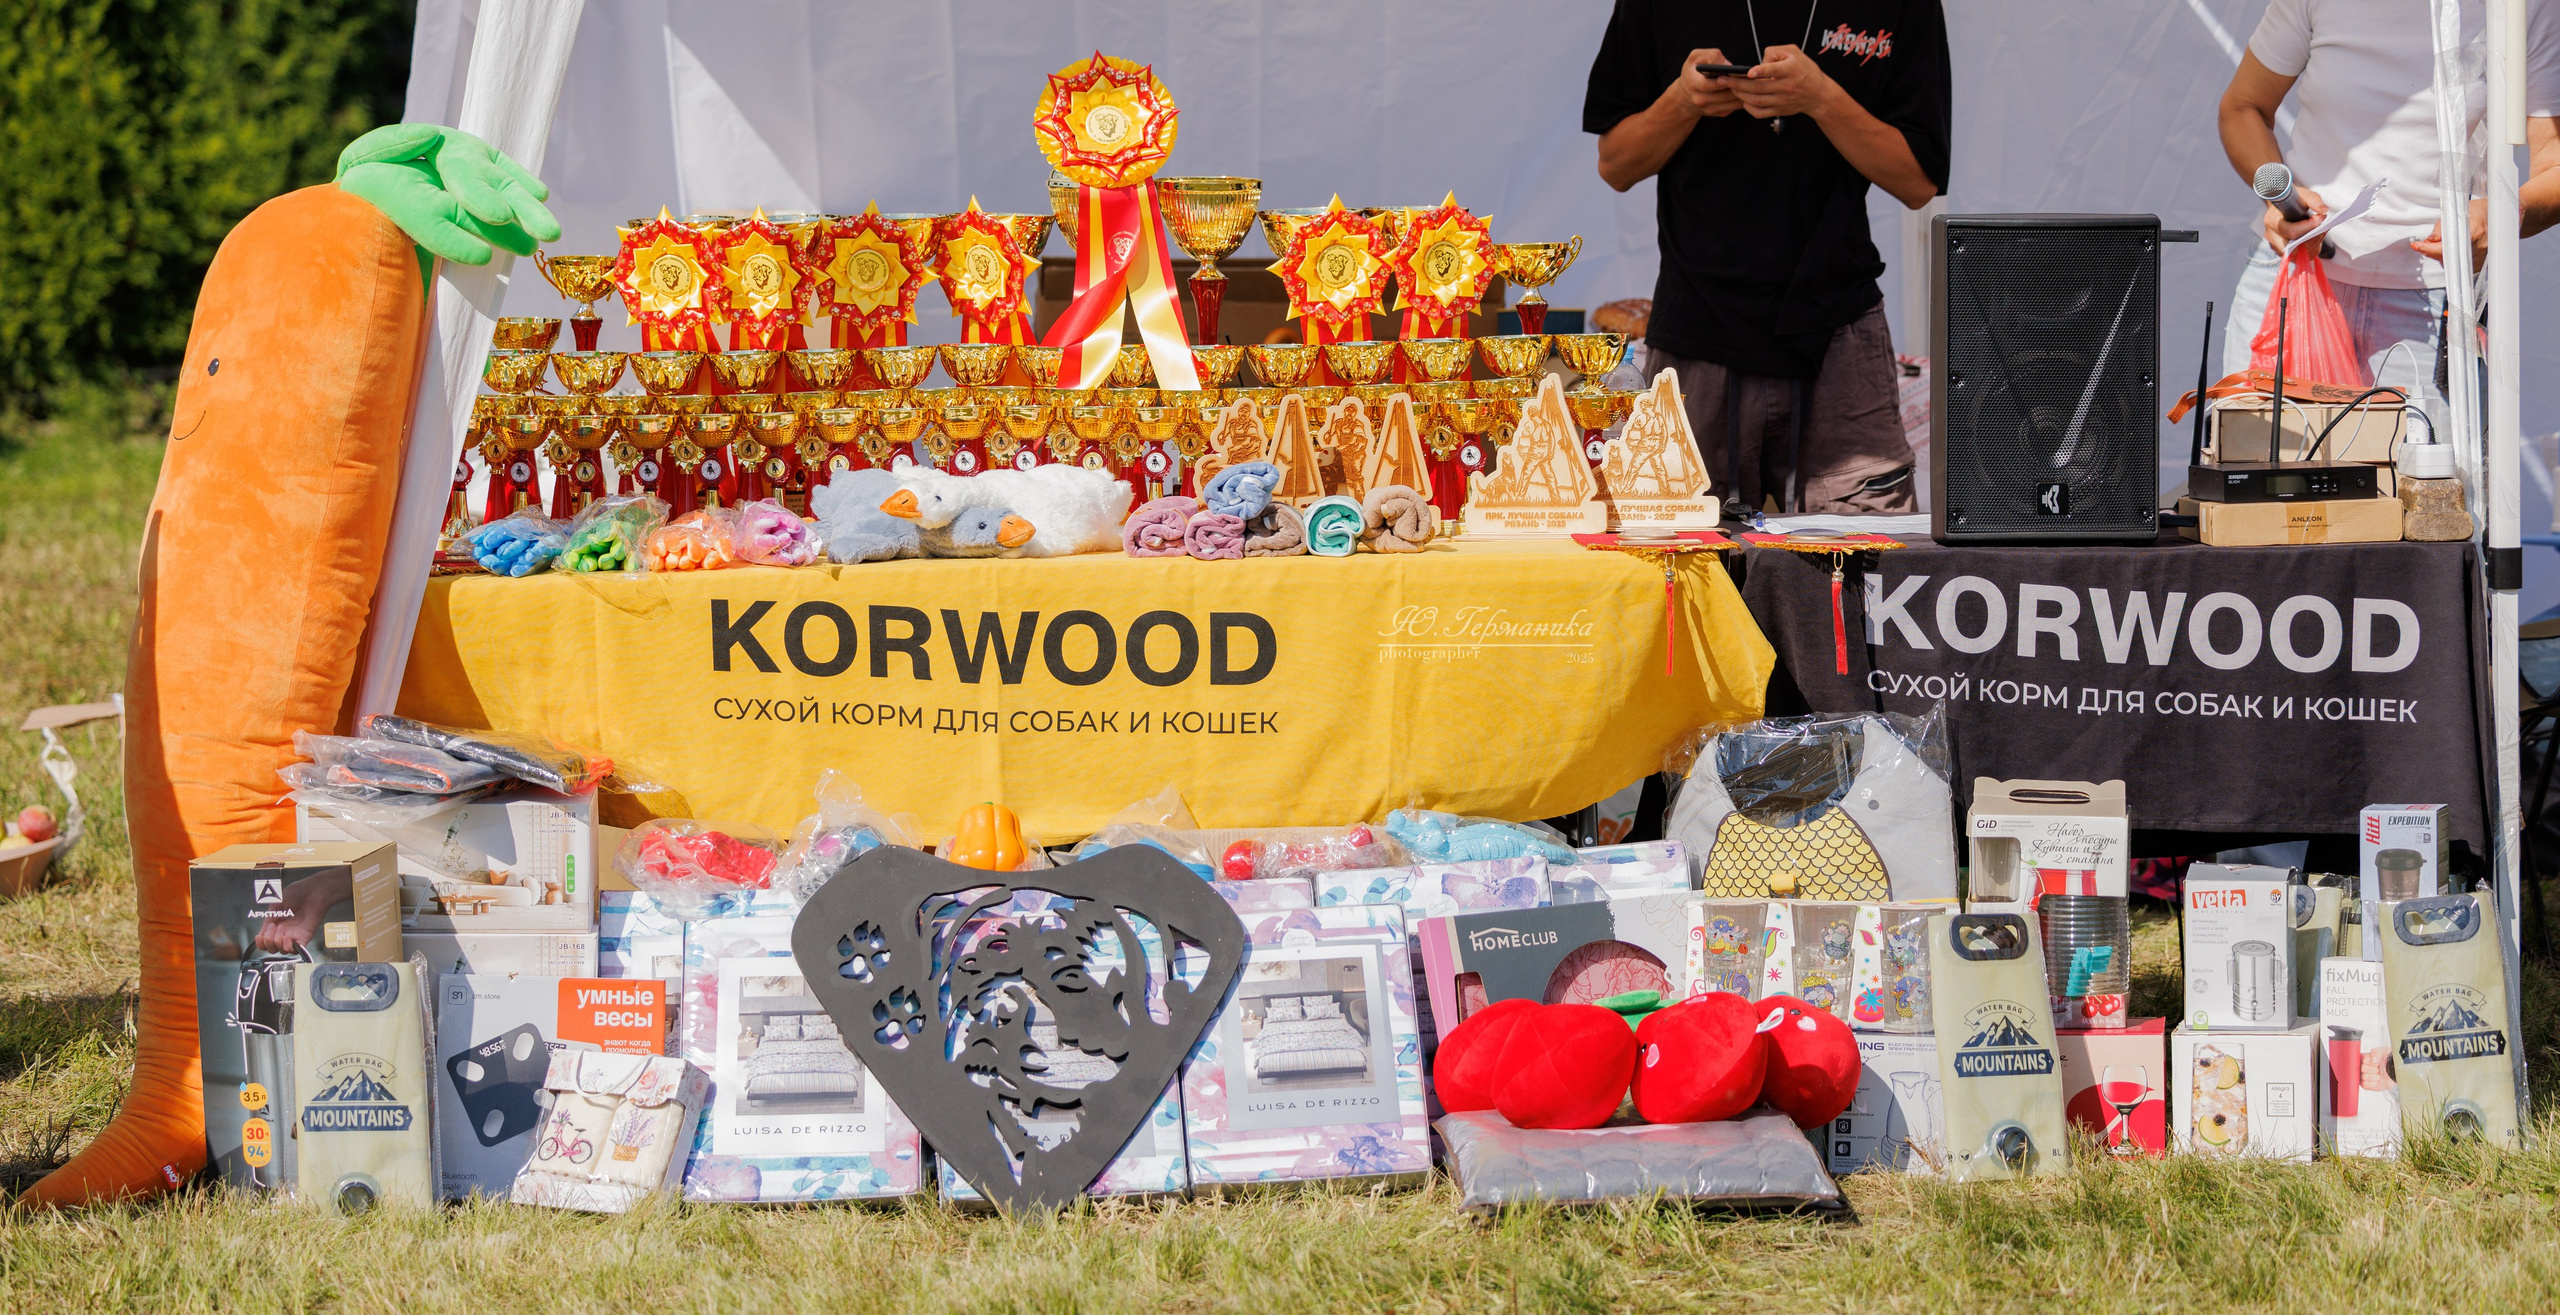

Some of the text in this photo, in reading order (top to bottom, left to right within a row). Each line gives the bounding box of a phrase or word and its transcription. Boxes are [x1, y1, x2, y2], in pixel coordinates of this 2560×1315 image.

[1619, 504, 1663, 513] ЛУЧШАЯ
[1665, 504, 1704, 513] СОБАКА
[1507, 511, 1546, 520] ЛУЧШАЯ
[1547, 511, 1585, 520] СОБАКА
[1608, 513, 1647, 521] РЯЗАНЬ
[1653, 512, 1676, 521] 2025
[1504, 520, 1541, 529] РЯЗАНЬ
[1546, 520, 1567, 528] 2025
[1864, 573, 2421, 674] KORWOOD
[709, 598, 1278, 687] KORWOOD
[1867, 669, 2418, 723] СУХОЙ КОРМ ДЛЯ СОБАК И КОШЕК
[712, 696, 1279, 736] СУХОЙ КОРМ ДЛЯ СОБАК И КОШЕК
[550, 811, 577, 819] JB-168
[2388, 815, 2431, 826] EXPEDITION
[1976, 819, 1998, 829] GiD
[2366, 814, 2380, 846] Hitt
[2047, 822, 2084, 841] Набор
[2029, 839, 2091, 858] Кувшин и
[2053, 853, 2114, 865] 2 стакана
[1470, 930, 1558, 952] HOMECLUB
[2326, 968, 2382, 987] fixMug
[2326, 986, 2348, 995] FALL
[2422, 988, 2472, 1001] WATER BAG
[577, 987, 655, 1010] умные
[1975, 1004, 2023, 1015] WATER BAG
[2325, 1008, 2349, 1017] MUG
[594, 1010, 653, 1028] весы
[604, 1039, 651, 1048] знают когда
[2407, 1034, 2499, 1060] MOUNTAINS
[605, 1047, 651, 1055] промолчать
[330, 1057, 384, 1068] WATER BAG
[1962, 1052, 2048, 1074] MOUNTAINS
[1248, 1097, 1380, 1112] LUISA DE RIZZO
[309, 1108, 404, 1128] MOUNTAINS
[246, 1127, 265, 1140] 30
[734, 1124, 867, 1136] LUISA DE RIZZO
[247, 1145, 265, 1158] 94
[2052, 1148, 2062, 1157] 8L
[162, 1164, 179, 1183] FANCY
[441, 1171, 478, 1181] Bluetooth
[442, 1182, 461, 1191] scale
